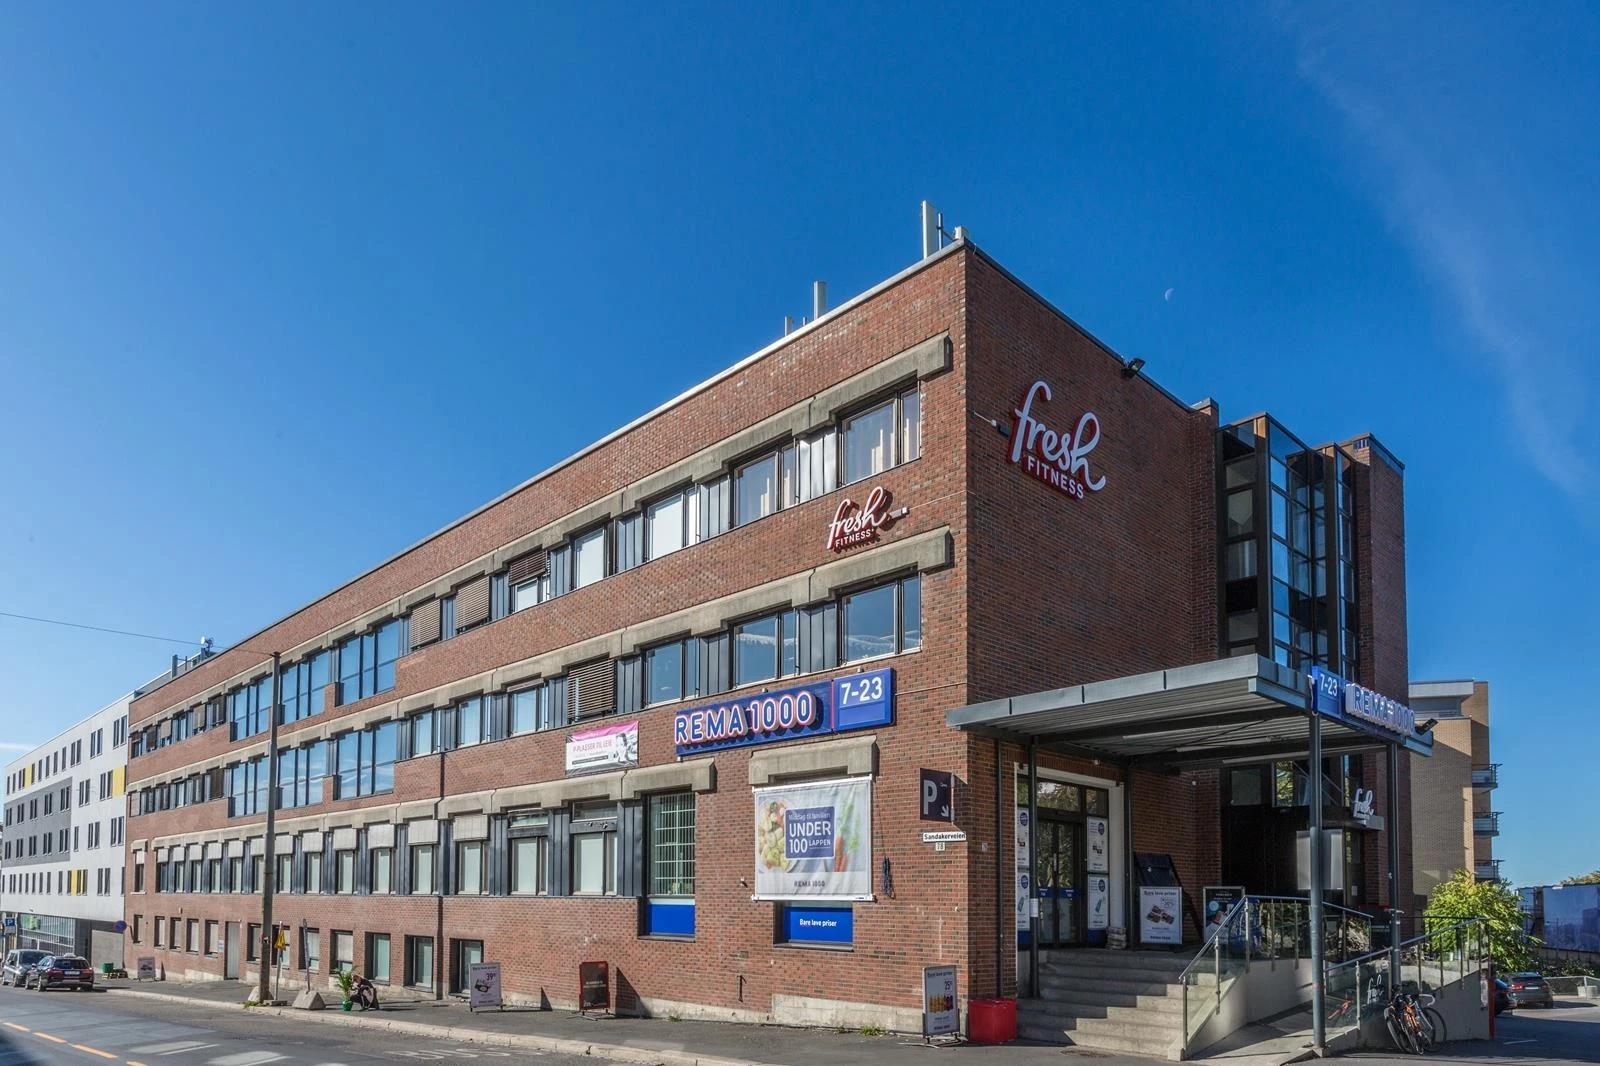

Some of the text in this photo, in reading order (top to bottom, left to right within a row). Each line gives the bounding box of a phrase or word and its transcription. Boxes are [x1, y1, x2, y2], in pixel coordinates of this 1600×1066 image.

[1012, 381, 1106, 491] fresh
[1027, 455, 1084, 499] FITNESS
[827, 486, 888, 549] fresh
[835, 529, 872, 547] FITNESS
[839, 676, 883, 705] 7-23
[1320, 673, 1338, 697] 7-23
[674, 691, 812, 744] REMA 1000
[1352, 686, 1389, 720] REMA
[923, 779, 938, 815] P
[789, 821, 831, 837] UNDER
[924, 832, 966, 840] Sandakerveien
[789, 838, 808, 853] 100
[800, 918, 811, 926] Bare
